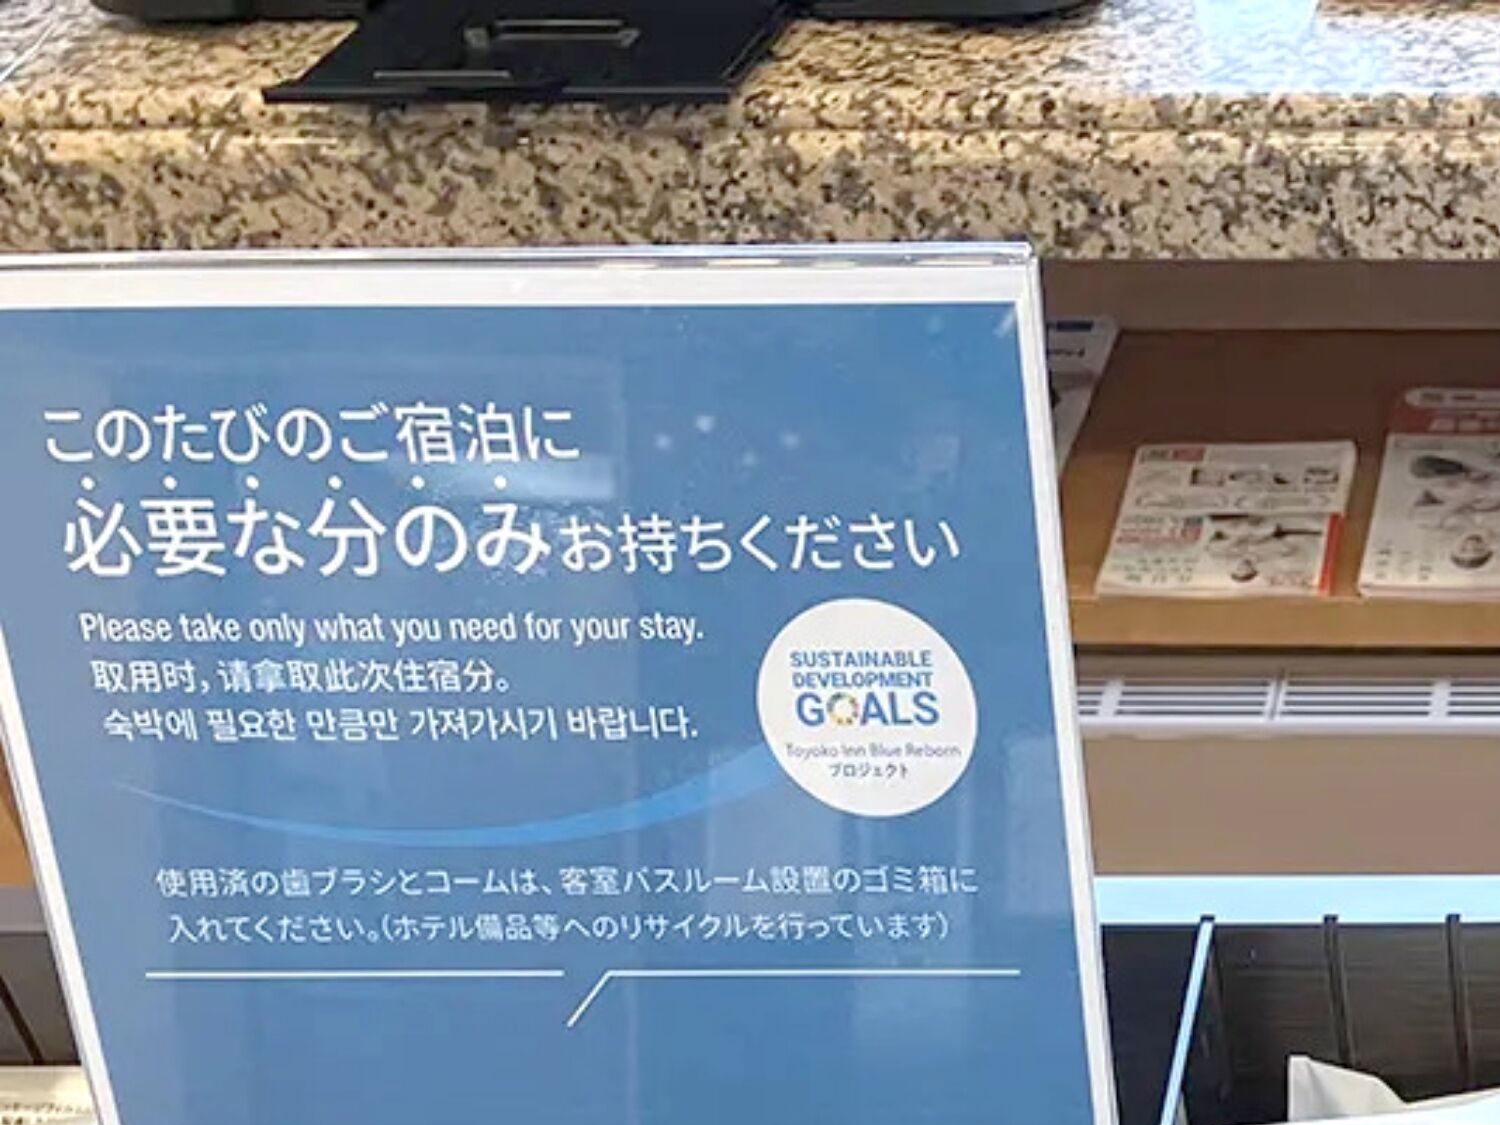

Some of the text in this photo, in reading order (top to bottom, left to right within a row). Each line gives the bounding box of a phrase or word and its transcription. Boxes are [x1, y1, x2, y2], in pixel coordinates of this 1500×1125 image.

[43, 401, 581, 464] このたびのご宿泊に
[63, 496, 961, 577] 必要な分のみお持ちください
[80, 611, 704, 647] Please take only what you need for your stay.
[790, 651, 933, 667] SUSTAINABLE
[792, 672, 933, 687] DEVELOPMENT
[104, 706, 699, 742] 숙박에 필요한 만큼만 가져가시기 바랍니다.
[796, 691, 940, 726] GOALS
